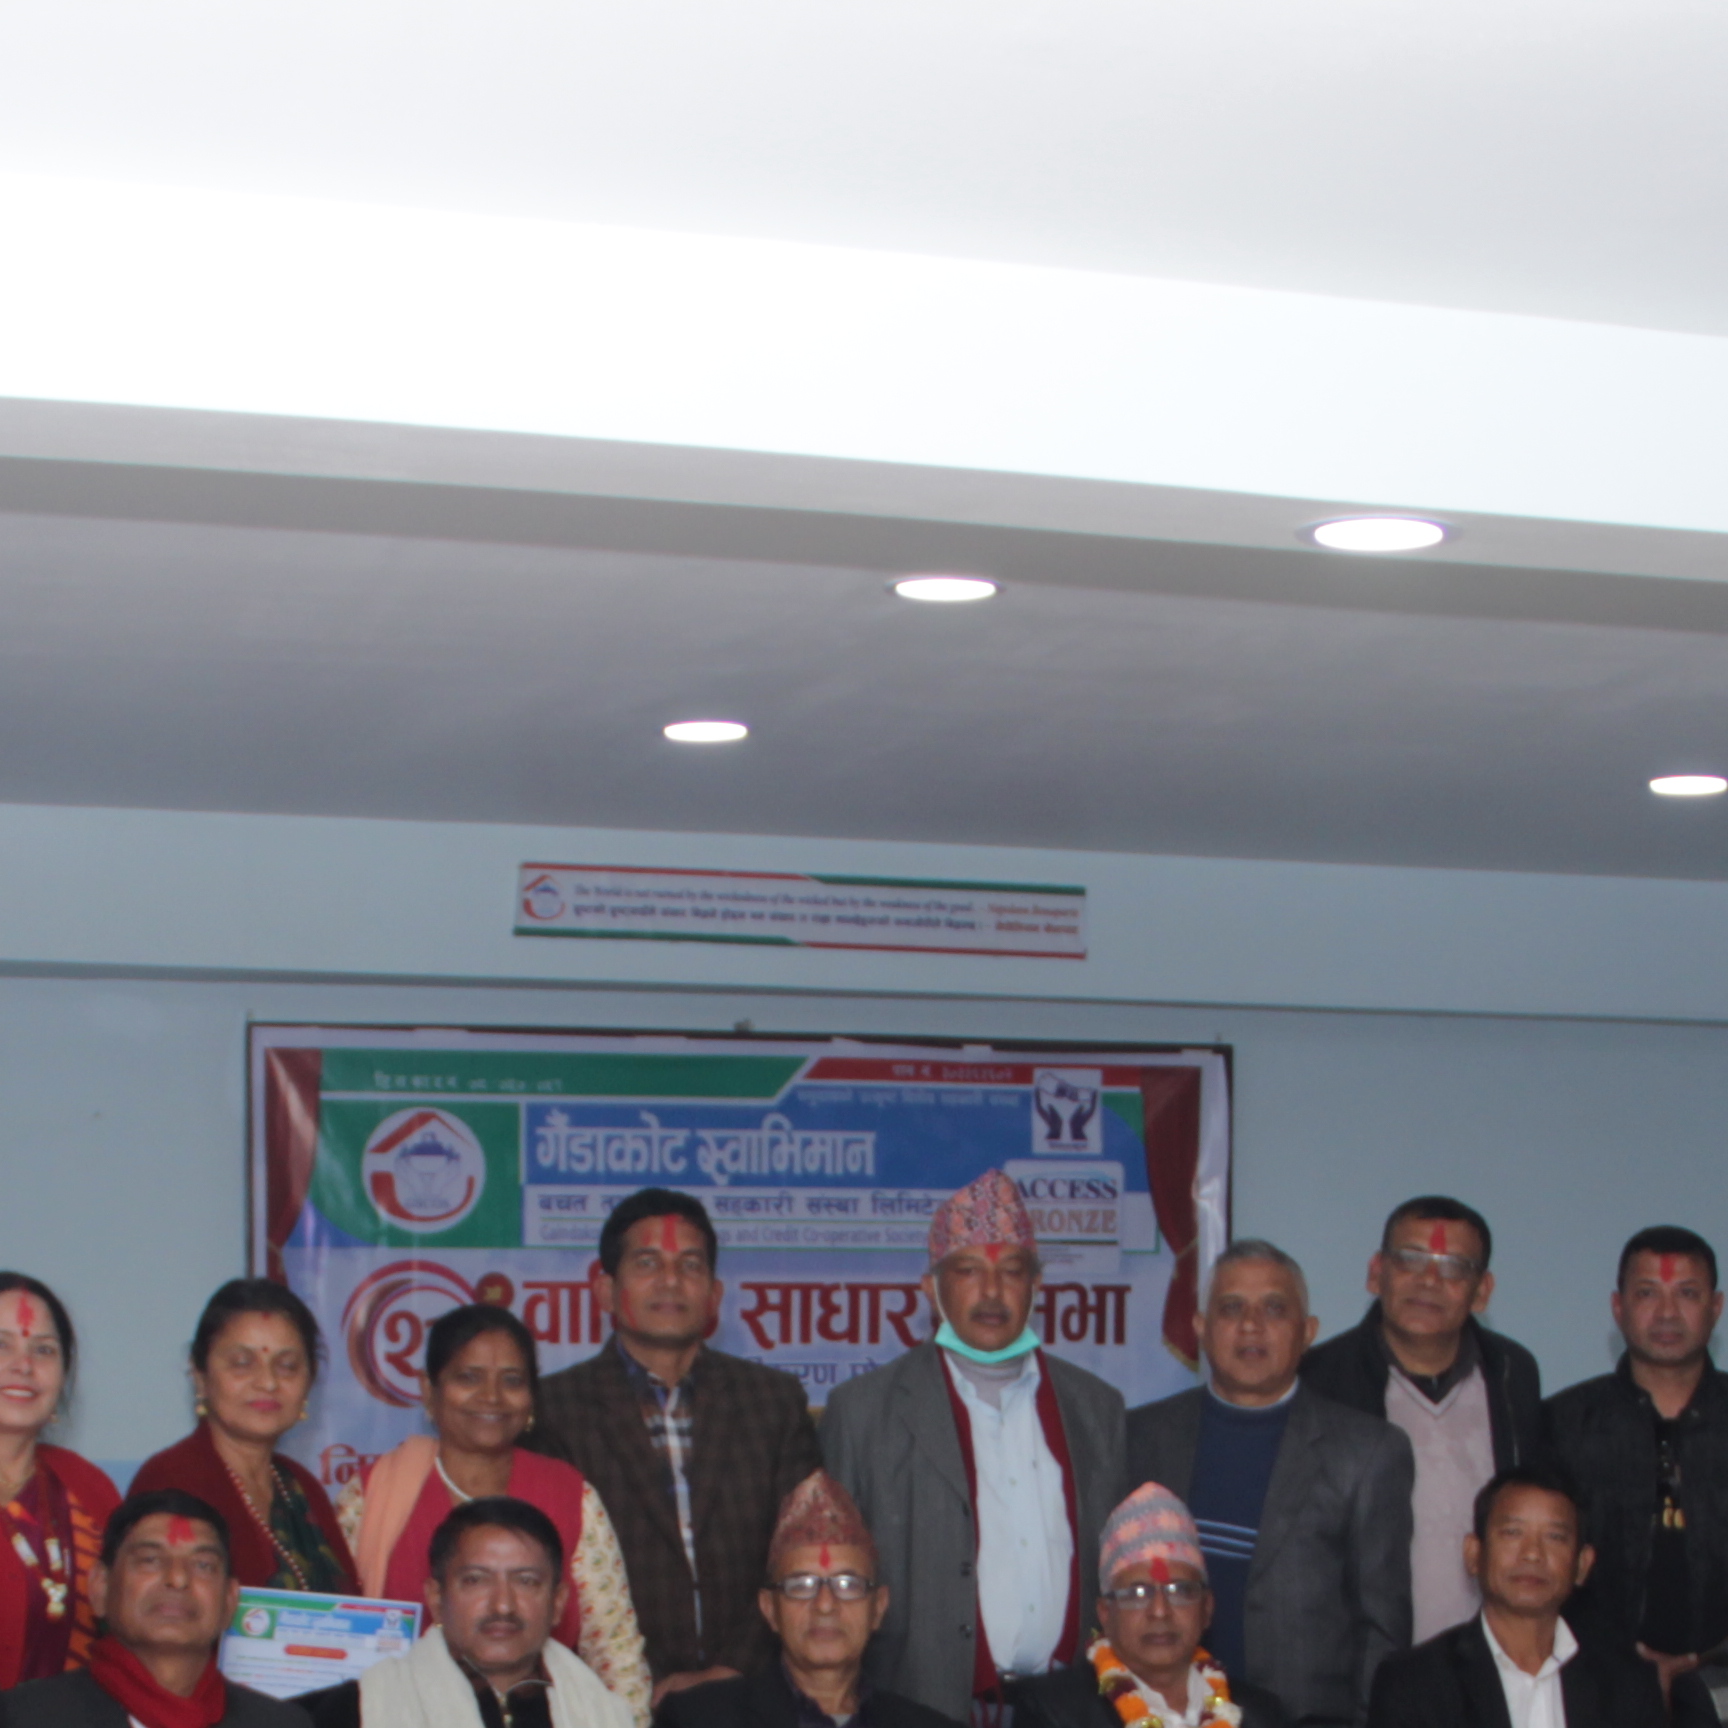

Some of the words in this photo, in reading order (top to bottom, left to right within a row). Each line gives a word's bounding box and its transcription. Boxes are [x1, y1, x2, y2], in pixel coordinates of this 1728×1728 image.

[696, 1112, 877, 1187] स्वाभिमान
[537, 1193, 588, 1213] बचत
[714, 1189, 794, 1214] सहकारी
[806, 1192, 860, 1215] संस्था
[871, 1189, 936, 1216] लिमिटे
[762, 1226, 799, 1242] Credit
[739, 1280, 928, 1350] साधार
